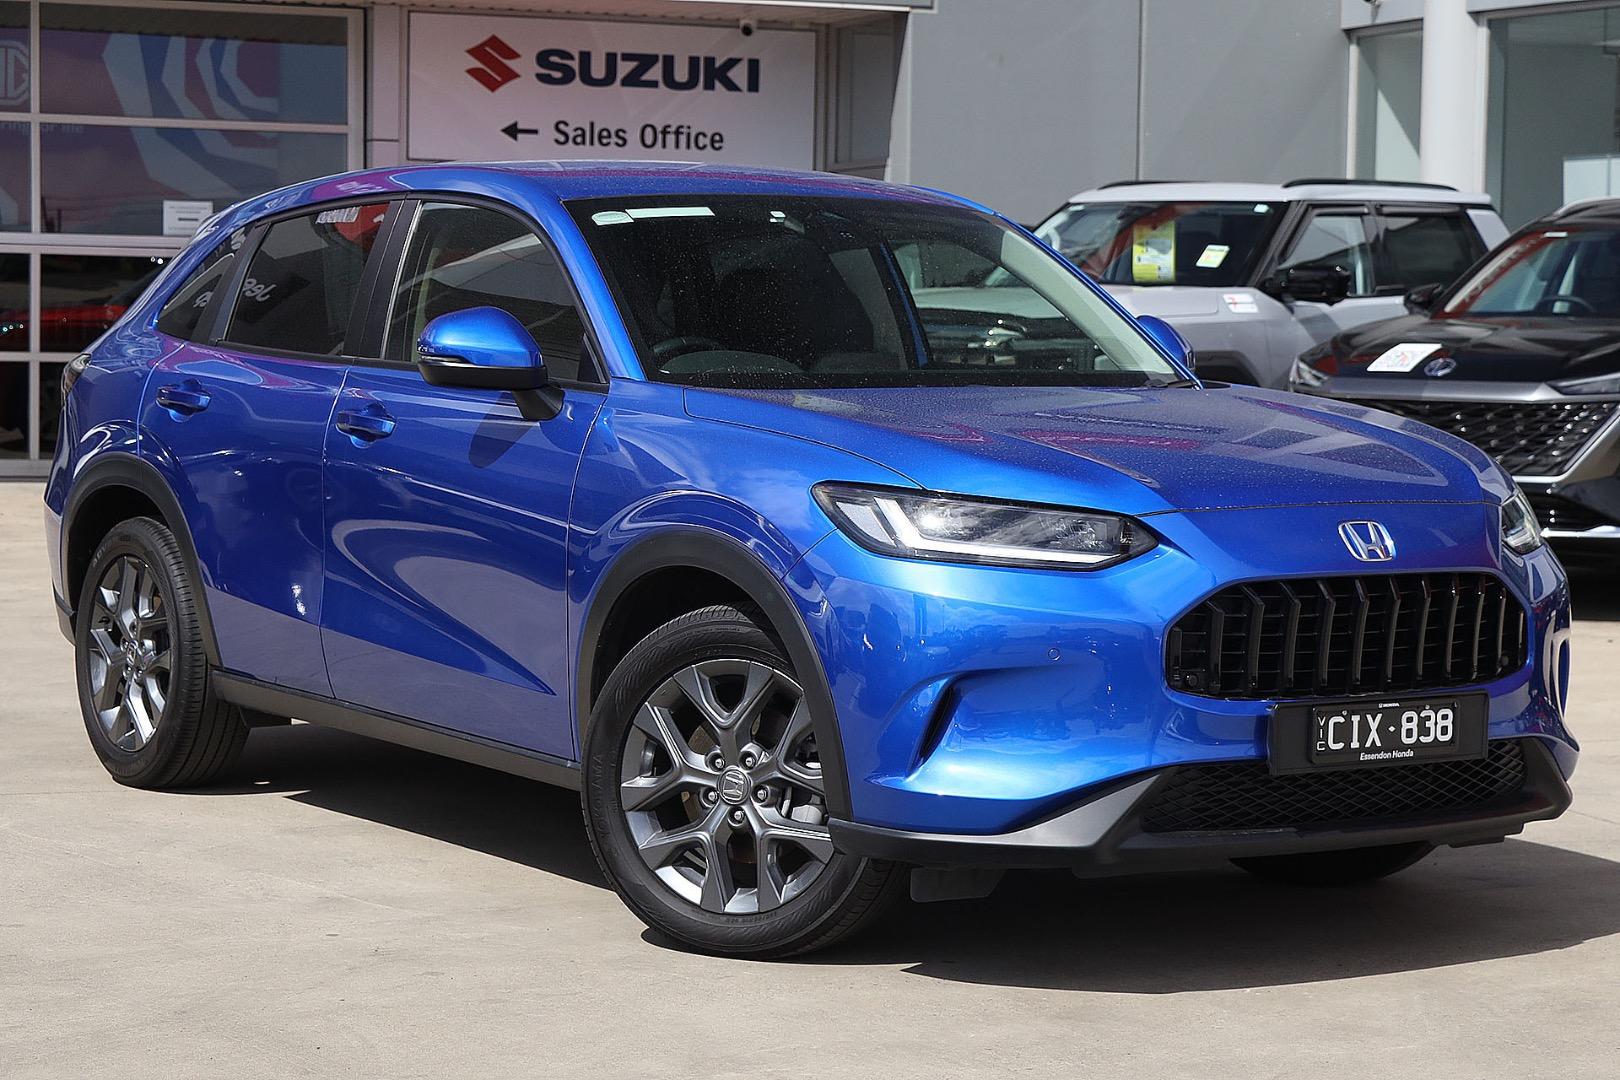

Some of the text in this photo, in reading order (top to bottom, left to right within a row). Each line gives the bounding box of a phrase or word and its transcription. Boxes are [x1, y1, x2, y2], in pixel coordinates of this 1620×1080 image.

[535, 48, 760, 93] SUZUKI
[553, 120, 725, 151] Sales Office
[1316, 716, 1326, 750] VIC
[1328, 708, 1454, 750] CIX 838
[1360, 748, 1414, 761] Essendon Honda
